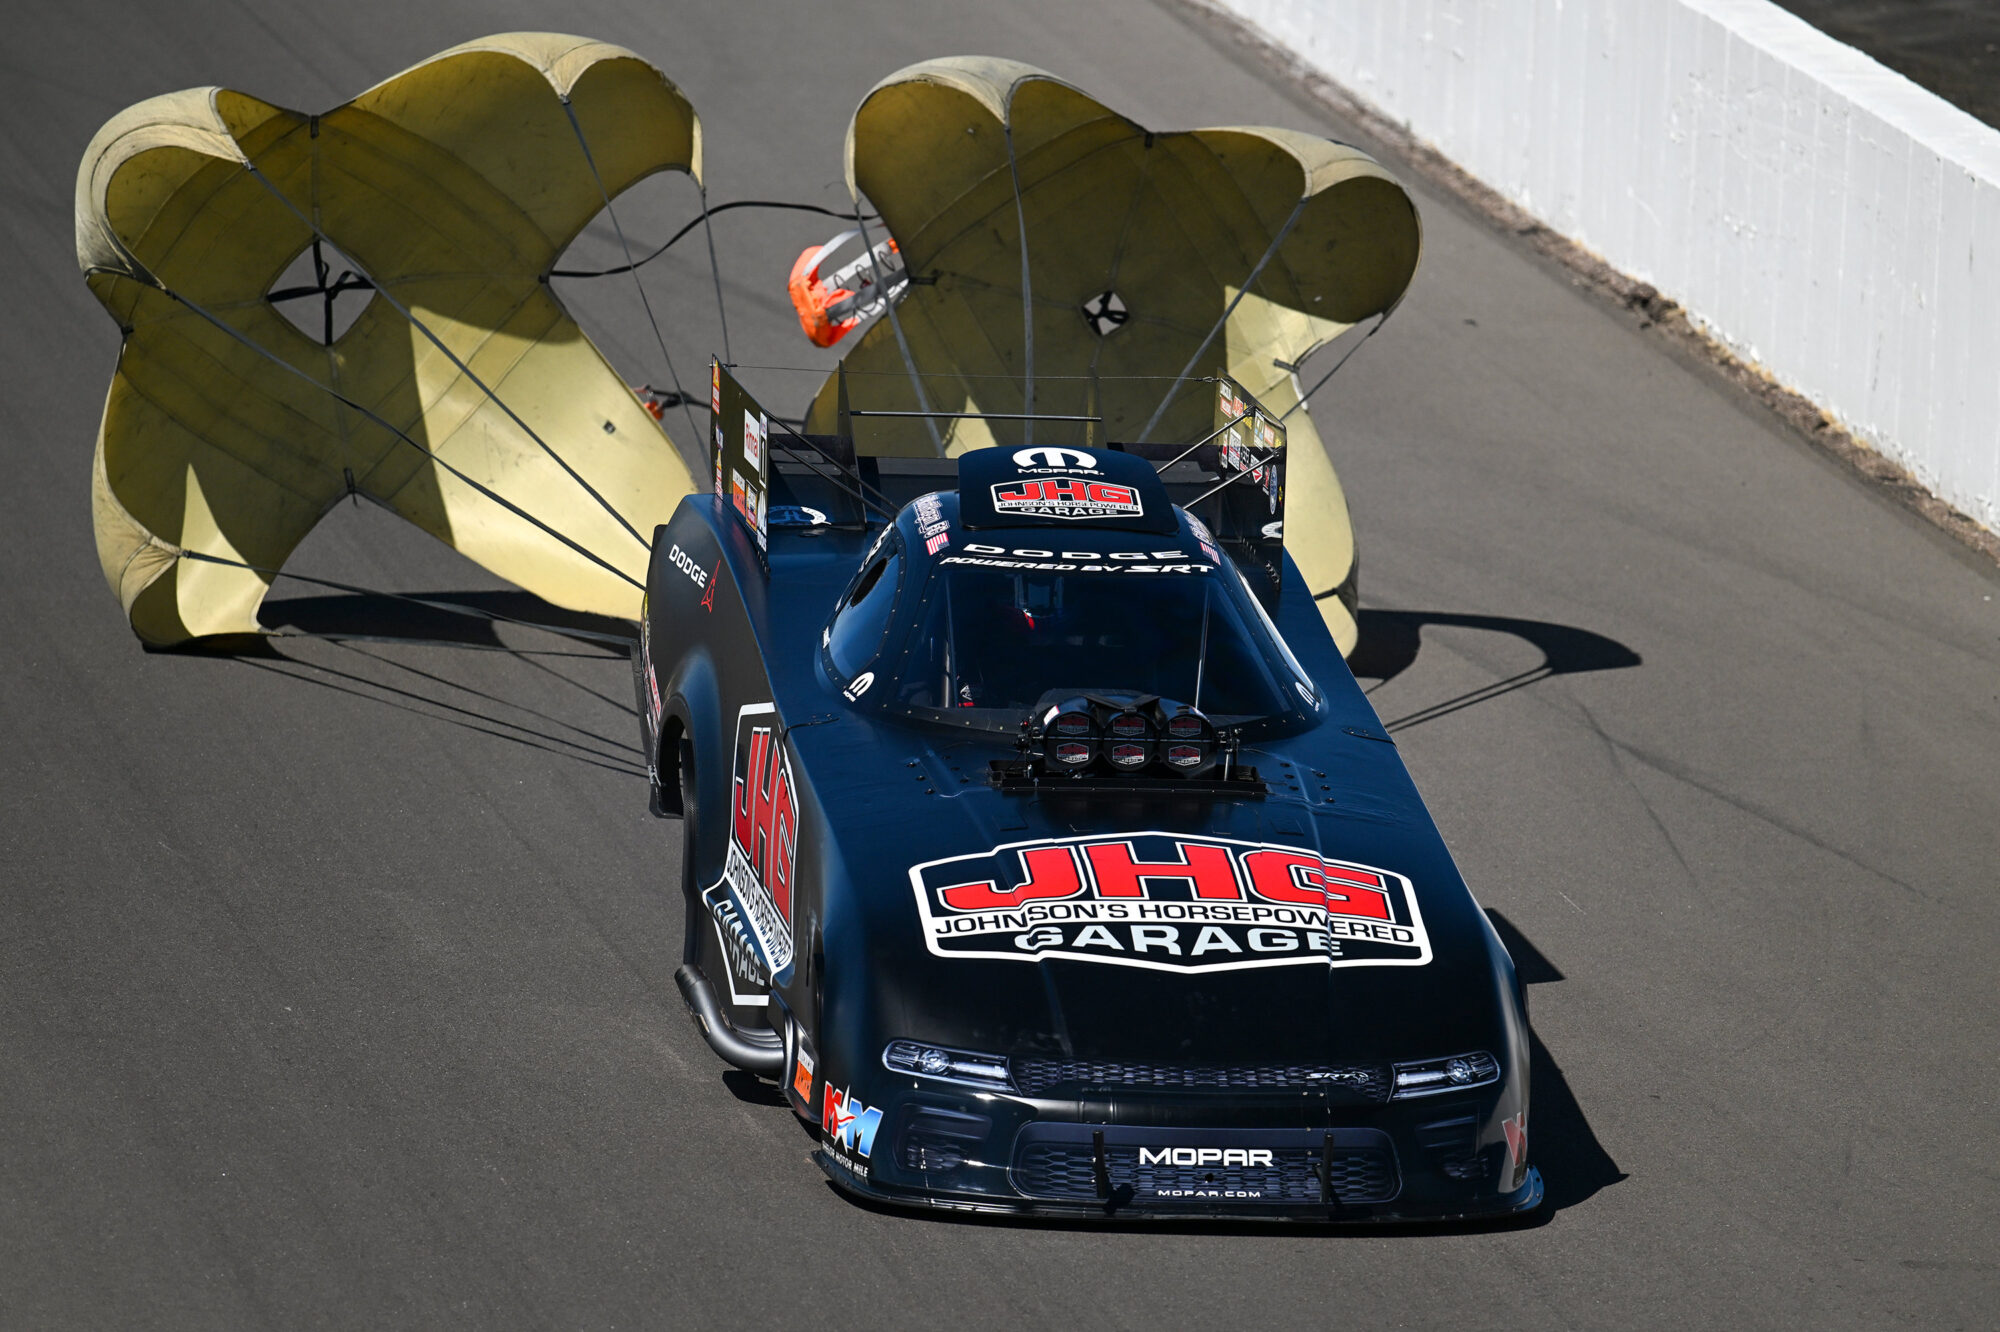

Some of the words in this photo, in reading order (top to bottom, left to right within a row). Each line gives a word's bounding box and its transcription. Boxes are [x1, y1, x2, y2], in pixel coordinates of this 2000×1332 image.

[999, 480, 1133, 504] JHG
[1021, 507, 1118, 515] GARAGE
[1057, 501, 1139, 511] HORSEPOWERED
[963, 543, 1190, 560] DODGE
[669, 544, 708, 589] DODGE
[939, 556, 1077, 571] POWERED
[1124, 564, 1214, 574] SRT
[734, 727, 795, 934] JHG
[937, 841, 1396, 923] JHG
[936, 904, 1128, 935] JOHNSON'S
[1138, 903, 1415, 943] HORSEPOWERED
[1014, 924, 1344, 957] GARAGE
[1138, 1147, 1274, 1167] MOPAR
[1158, 1189, 1261, 1198] MOPAR.COM
